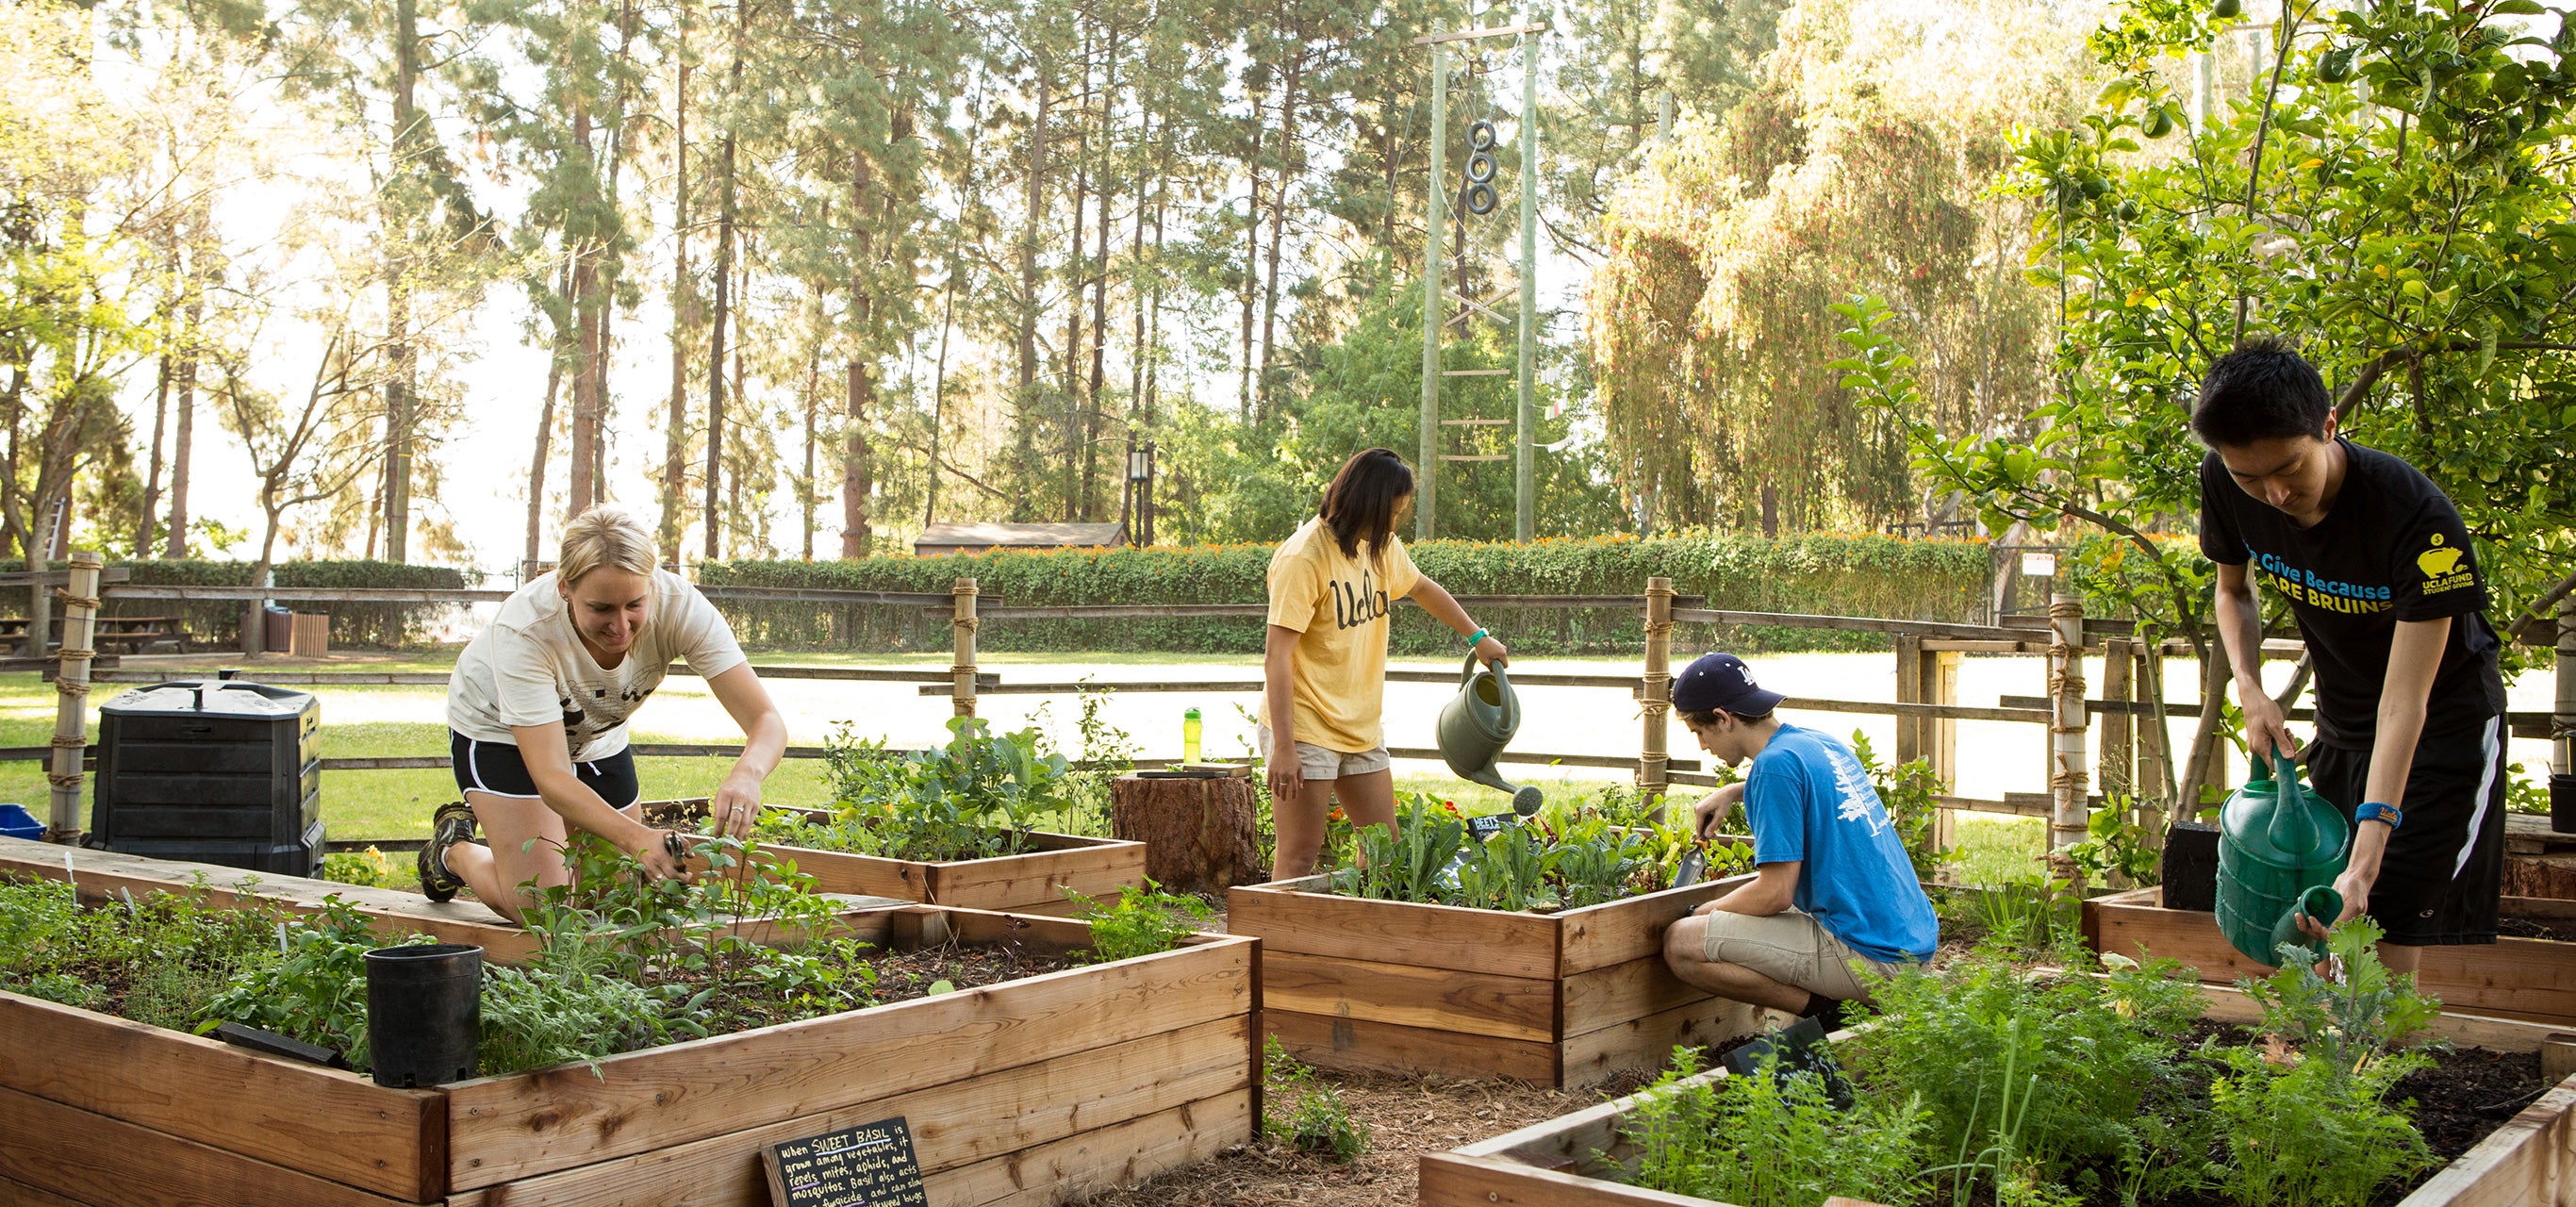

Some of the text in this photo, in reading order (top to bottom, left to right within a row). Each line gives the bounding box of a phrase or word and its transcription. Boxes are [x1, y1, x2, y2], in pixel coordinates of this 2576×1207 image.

[2261, 553, 2301, 583] Give
[2305, 569, 2391, 600] Because
[2268, 572, 2393, 614] ARE BRUINS
[2422, 572, 2472, 589] UCLA FUND
[2423, 580, 2474, 595] STUDENT GIVING
[1329, 568, 1390, 630] Ucla
[784, 1136, 908, 1177] grown among vegetables, it
[811, 1134, 849, 1152] SWEET
[856, 1128, 889, 1144] BASIL
[894, 1126, 903, 1134] is
[789, 1149, 907, 1187] repels mites, aphids, and
[792, 1165, 916, 1200] mosquitos. Basil also acts
[870, 1183, 886, 1198] and
[891, 1183, 905, 1193] can
[907, 1177, 922, 1188] slow
[902, 1192, 925, 1203] bugs.
